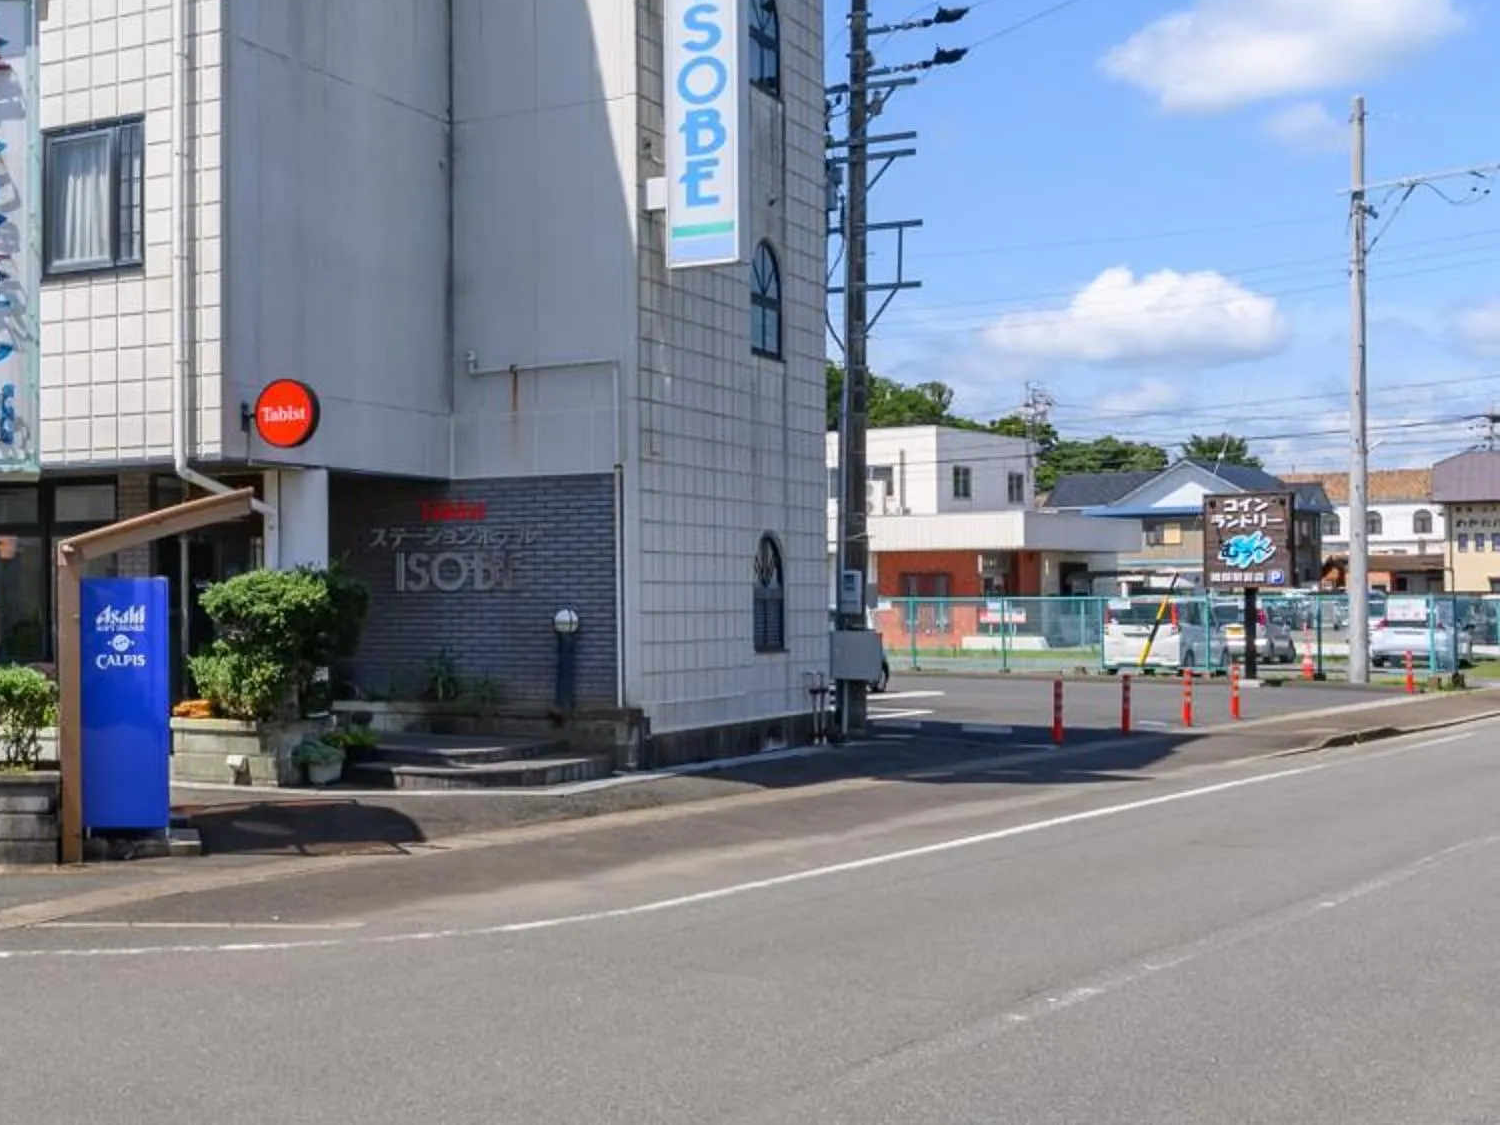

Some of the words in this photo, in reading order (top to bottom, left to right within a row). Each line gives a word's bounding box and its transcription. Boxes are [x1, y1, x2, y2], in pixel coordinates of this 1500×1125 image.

[260, 404, 306, 423] Tabist
[1223, 498, 1269, 512] コイン
[1211, 513, 1285, 528] ランドリー
[96, 604, 146, 624] Asahi
[95, 654, 146, 670] CALPIS
